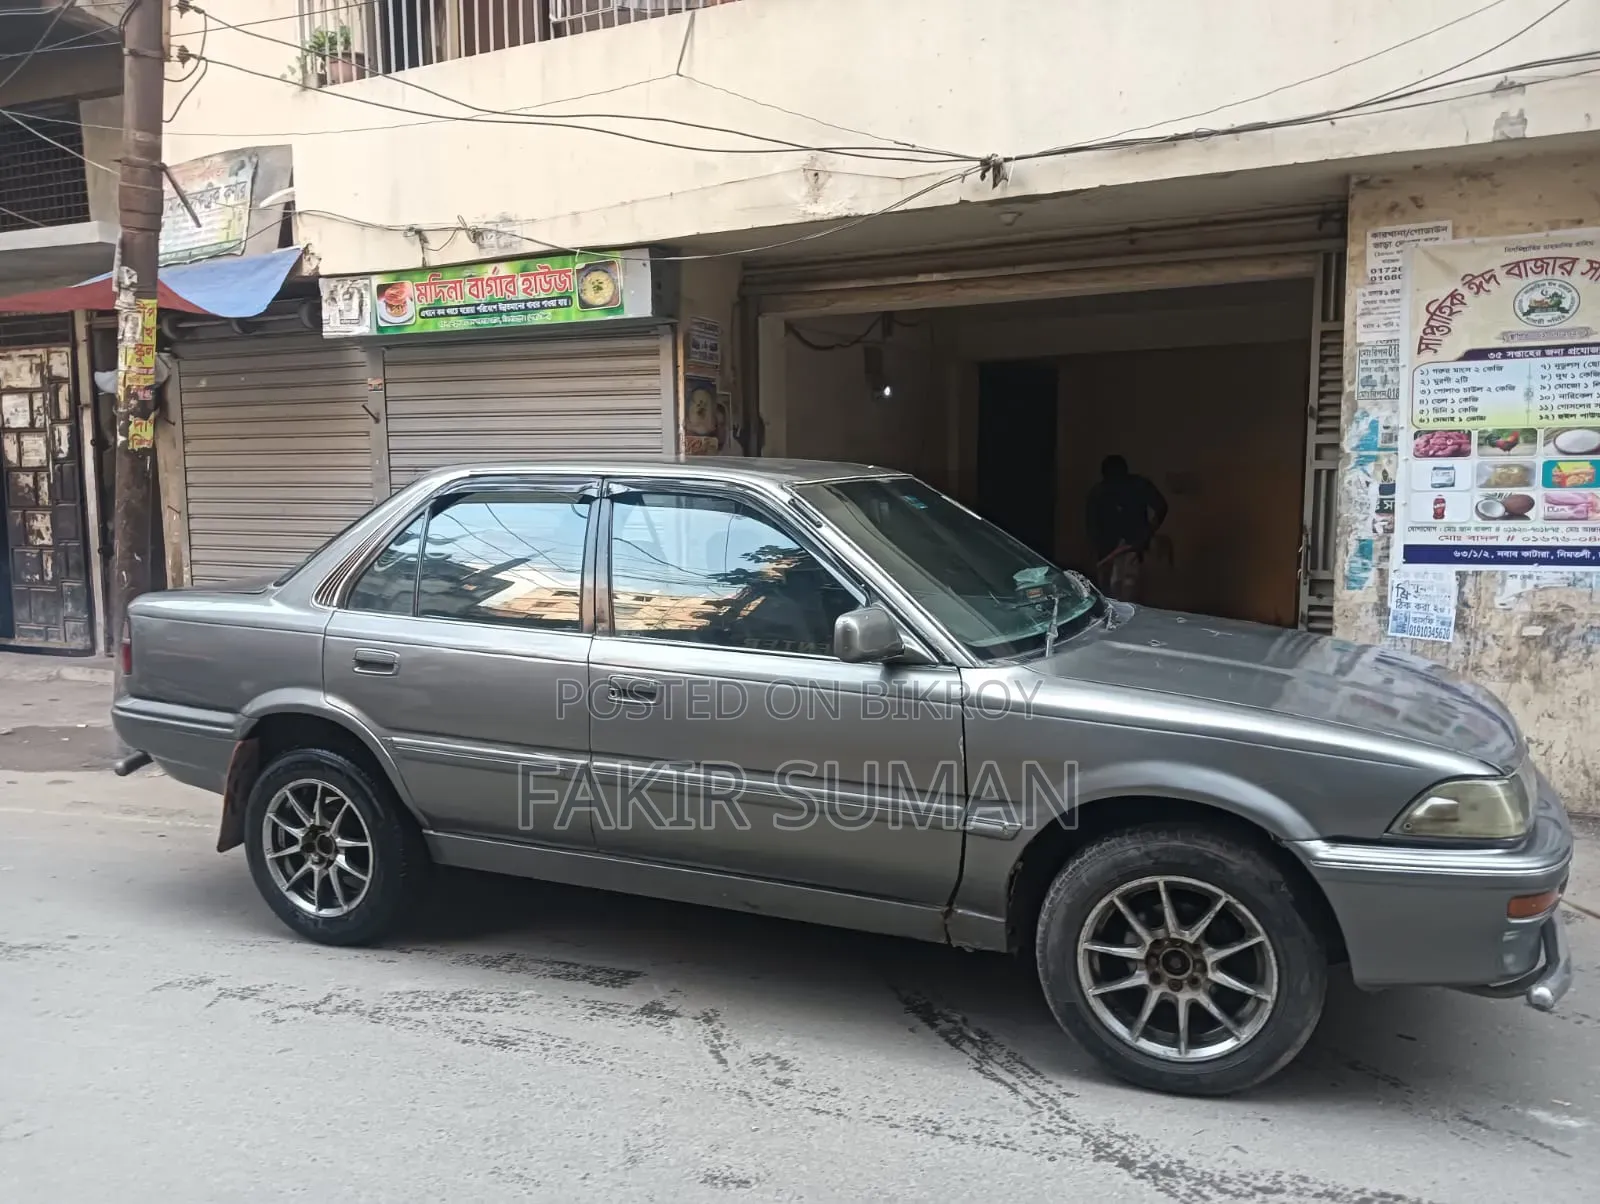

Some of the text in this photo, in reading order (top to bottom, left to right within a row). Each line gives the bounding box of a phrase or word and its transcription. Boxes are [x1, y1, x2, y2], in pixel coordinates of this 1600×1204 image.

[466, 266, 517, 300] বার্গার
[519, 263, 573, 297] হাউজ
[1461, 268, 1501, 295] ঈদ
[1500, 256, 1581, 279] বাজার
[1581, 259, 1600, 282] সা
